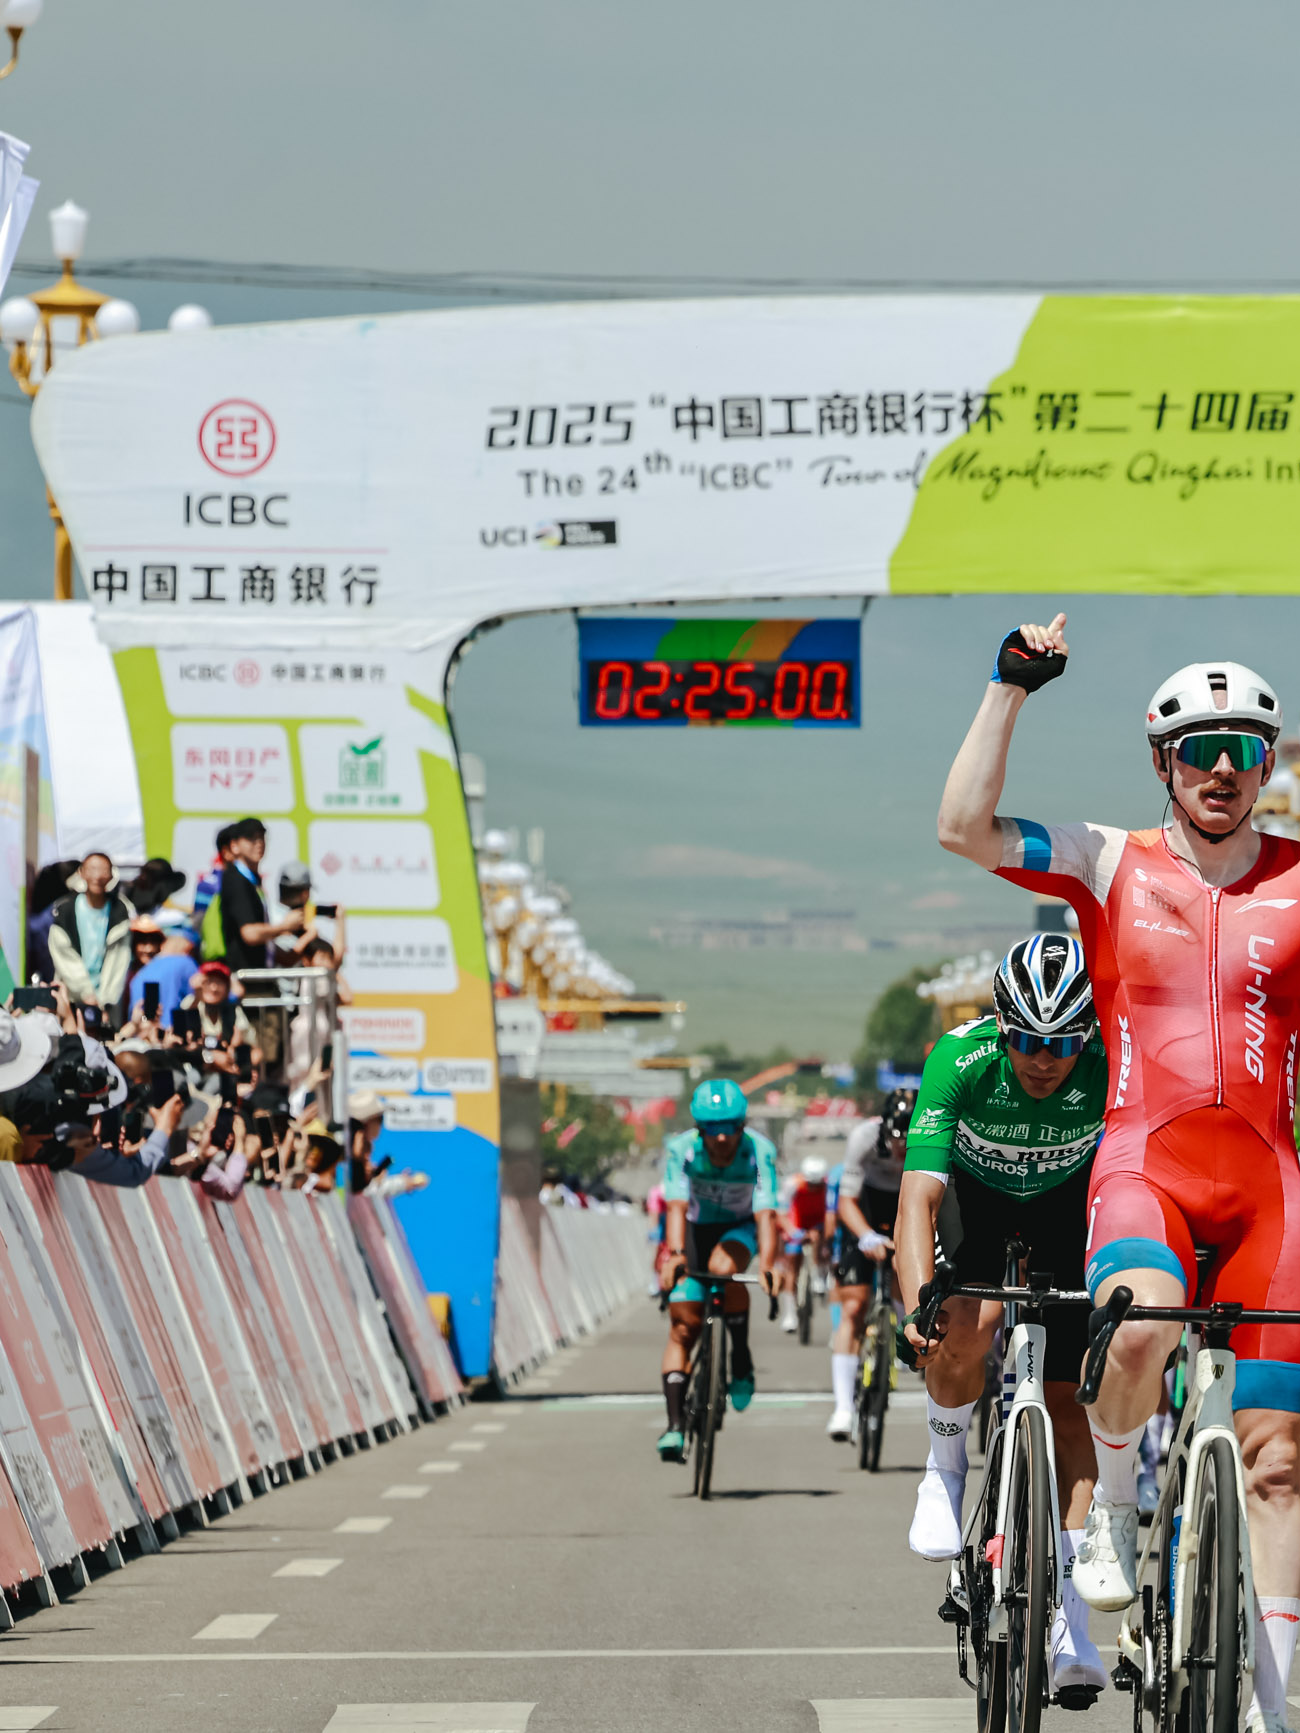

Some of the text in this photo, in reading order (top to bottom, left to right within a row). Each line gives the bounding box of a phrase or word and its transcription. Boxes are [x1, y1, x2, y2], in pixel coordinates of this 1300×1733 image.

[486, 402, 637, 450] 2025
[517, 470, 585, 498] The
[599, 451, 672, 495] 24th
[808, 454, 886, 489] Tour
[892, 449, 929, 492] of
[932, 449, 1112, 502] Magnificent
[1127, 449, 1255, 502] Qinghai
[185, 494, 289, 528] ICBC
[481, 528, 526, 547] UCI
[92, 562, 380, 604] 中国工商银行
[180, 664, 227, 682] ICBC
[272, 664, 387, 682] 中国工商银行
[185, 746, 282, 768] 东风日产
[209, 771, 255, 790] N7
[1244, 934, 1275, 1085] LI-NING
[954, 1040, 998, 1074] Santic
[1114, 1014, 1133, 1110] TREK
[1286, 1029, 1298, 1122] TREK
[1026, 1340, 1035, 1384] MMR
